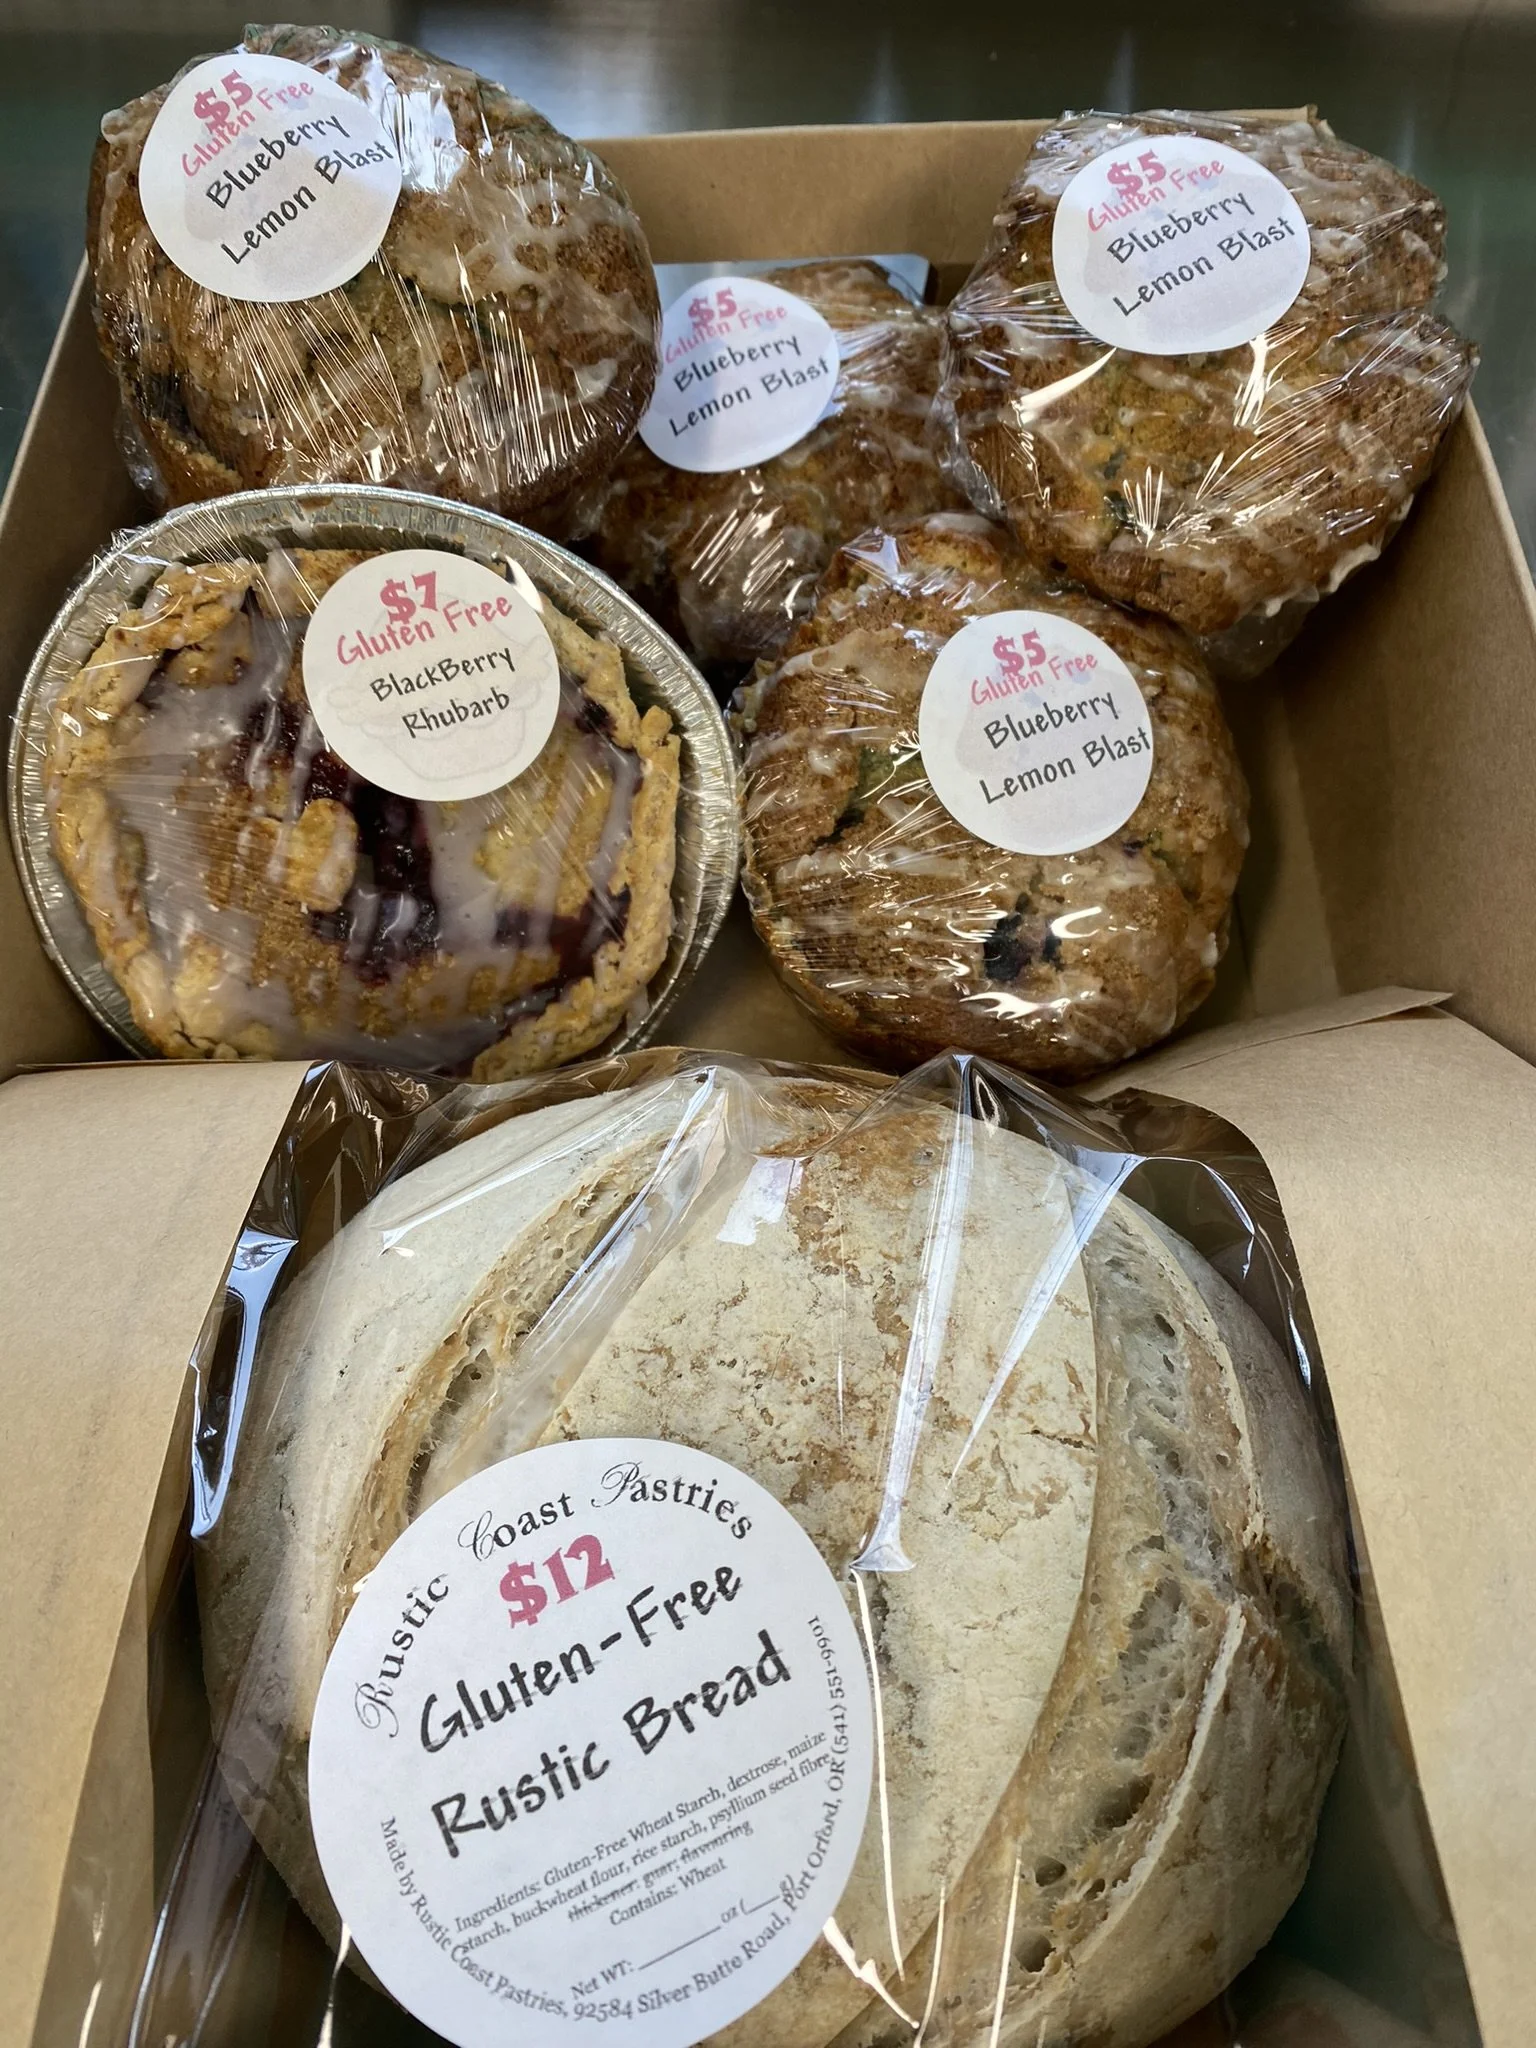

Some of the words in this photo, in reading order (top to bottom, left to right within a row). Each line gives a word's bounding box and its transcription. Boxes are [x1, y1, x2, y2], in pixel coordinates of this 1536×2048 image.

[181, 107, 256, 177] Gluten
[256, 81, 314, 111] Free
[193, 69, 254, 133] $5
[206, 115, 351, 209] Blueberry
[1107, 149, 1166, 199] $5
[220, 185, 317, 265] Lemon
[314, 141, 394, 185] Blast
[1087, 186, 1166, 233] Gluten
[1170, 159, 1225, 191] Free
[1107, 192, 1254, 264] Blueberry
[1113, 254, 1214, 317] Lemon
[1217, 217, 1296, 261] Blast
[665, 320, 731, 364] Gluten
[738, 305, 788, 330] Free
[688, 287, 738, 332] $5
[673, 335, 801, 393] Blueberry
[669, 385, 752, 437] Lemon
[760, 356, 829, 395] Blast
[380, 571, 439, 625] $7
[337, 619, 435, 666] Gluten
[442, 596, 513, 632] Free
[993, 628, 1047, 675] $5
[370, 648, 516, 702] BlackBerry
[970, 669, 1044, 705] Gluten
[1047, 653, 1098, 681] Free
[402, 686, 511, 738] Rhubarb
[983, 692, 1119, 750] Blueberry
[979, 757, 1076, 805] Lemon
[1082, 727, 1151, 768] Blast
[354, 1572, 449, 1738] Rustic
[457, 1492, 575, 1562] Coast
[591, 1460, 752, 1541] Pastries
[499, 1533, 616, 1629] $12
[420, 1565, 742, 1753] Gluten-Free
[807, 1615, 845, 1699] 551-9901
[431, 1742, 610, 1859] Rustic
[623, 1629, 792, 1755] Bread
[830, 1703, 849, 1754] (541)
[825, 1760, 846, 1792] OR
[381, 1816, 407, 1874] Made
[455, 1882, 541, 1934] Ingredients:
[543, 1836, 629, 1888] Gluten-Free
[628, 1811, 675, 1844] Wheat
[676, 1787, 727, 1820] Starch,
[727, 1755, 787, 1793] dextrose,
[787, 1731, 827, 1761] maize
[512, 1879, 588, 1928] buckwheat
[589, 1858, 631, 1889] flour,
[632, 1844, 658, 1867] rice
[661, 1821, 708, 1853] starch,
[708, 1787, 767, 1831] psyllium
[769, 1768, 799, 1794] seed
[807, 1797, 843, 1869] Orford,
[399, 1869, 417, 1897] by
[609, 1884, 679, 1926] Contains:
[678, 1856, 727, 1890] Wheat
[411, 1894, 452, 1952] Rustic
[740, 1911, 791, 1961] Road,
[450, 1943, 494, 1988] Coast
[570, 1976, 601, 2001] Net
[600, 1959, 635, 1985] WT:
[692, 1955, 743, 1993] Butte
[491, 1974, 569, 2018] Pastries,
[573, 1998, 634, 2023] 92584
[637, 1983, 692, 2014] Silver
